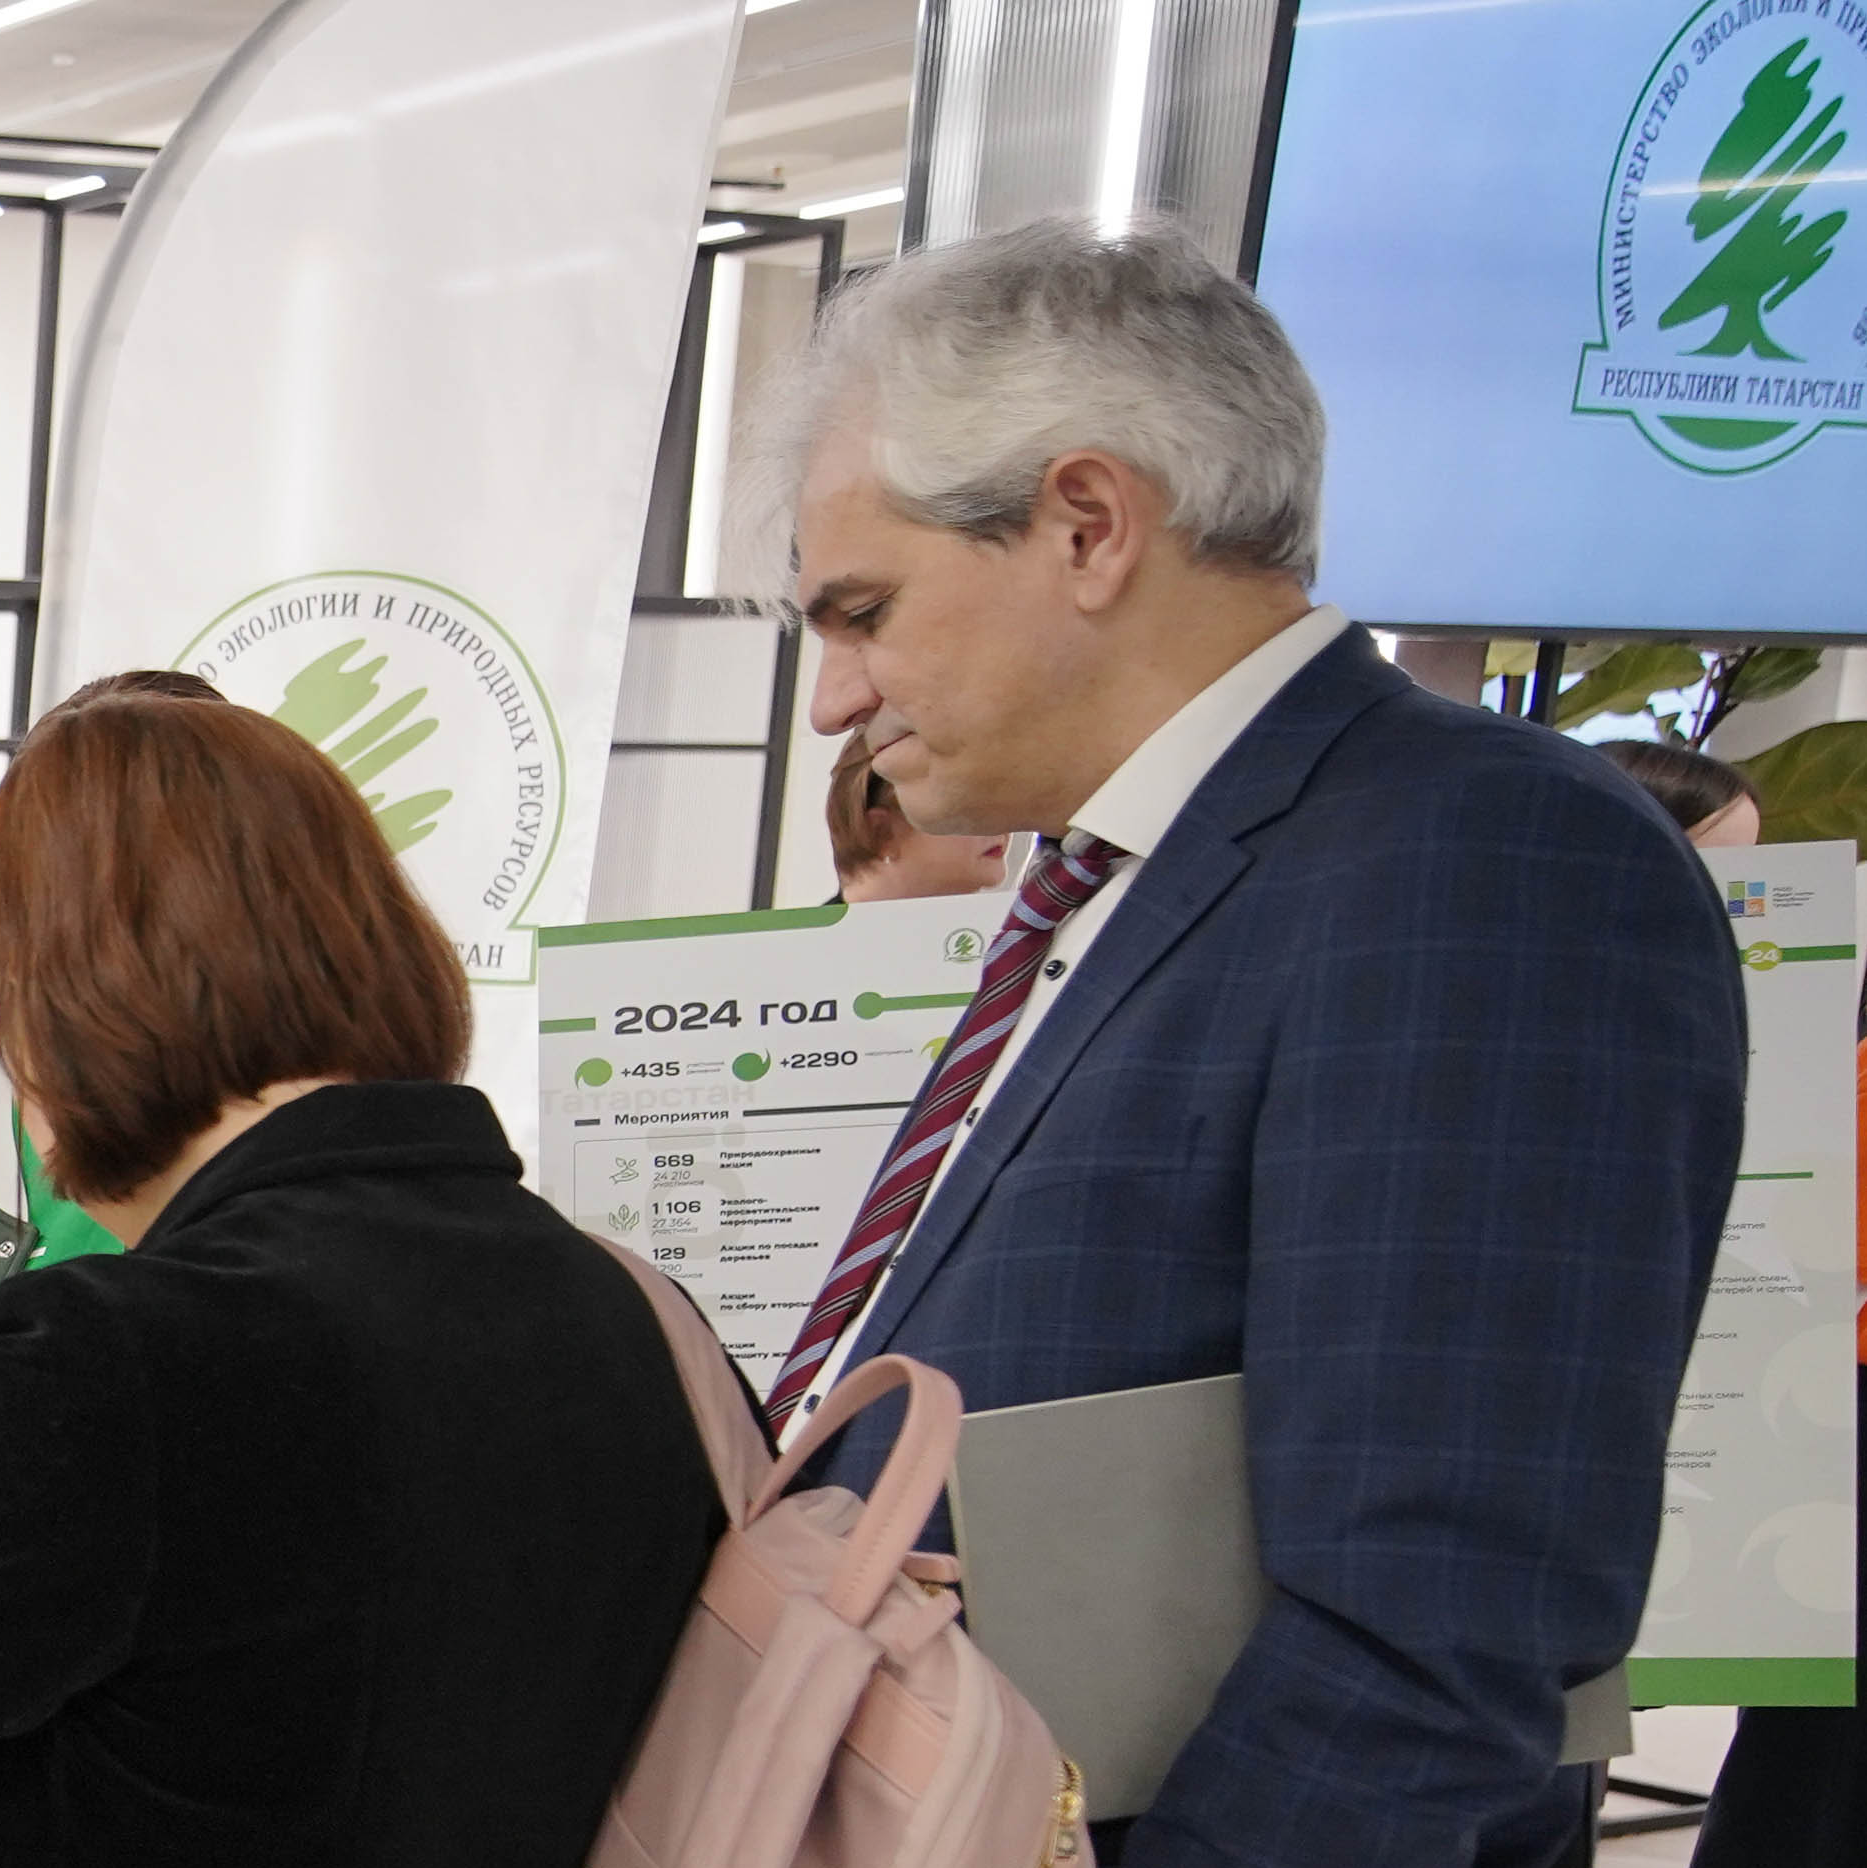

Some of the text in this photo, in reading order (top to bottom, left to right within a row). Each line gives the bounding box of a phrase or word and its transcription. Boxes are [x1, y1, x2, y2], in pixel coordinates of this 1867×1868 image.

[1611, 62, 1689, 333] МИНИСТЕРСТВО
[1600, 368, 1865, 410] РЕСПУБЛИКИ ТАТАРСТАН
[218, 592, 362, 664] ЭКОЛОГИИ
[375, 595, 396, 621] И
[406, 602, 539, 752] ПРИРОДНЫХ
[482, 762, 545, 912] РЕСУРСОВ
[1748, 950, 1779, 963] 24
[614, 999, 838, 1036] 2024 год
[780, 1050, 858, 1070] +2290
[621, 1062, 681, 1079] +435
[614, 1110, 730, 1127] Мероприятия
[654, 1154, 694, 1168] 669
[666, 1200, 701, 1214] 106
[652, 1247, 686, 1260] 129
